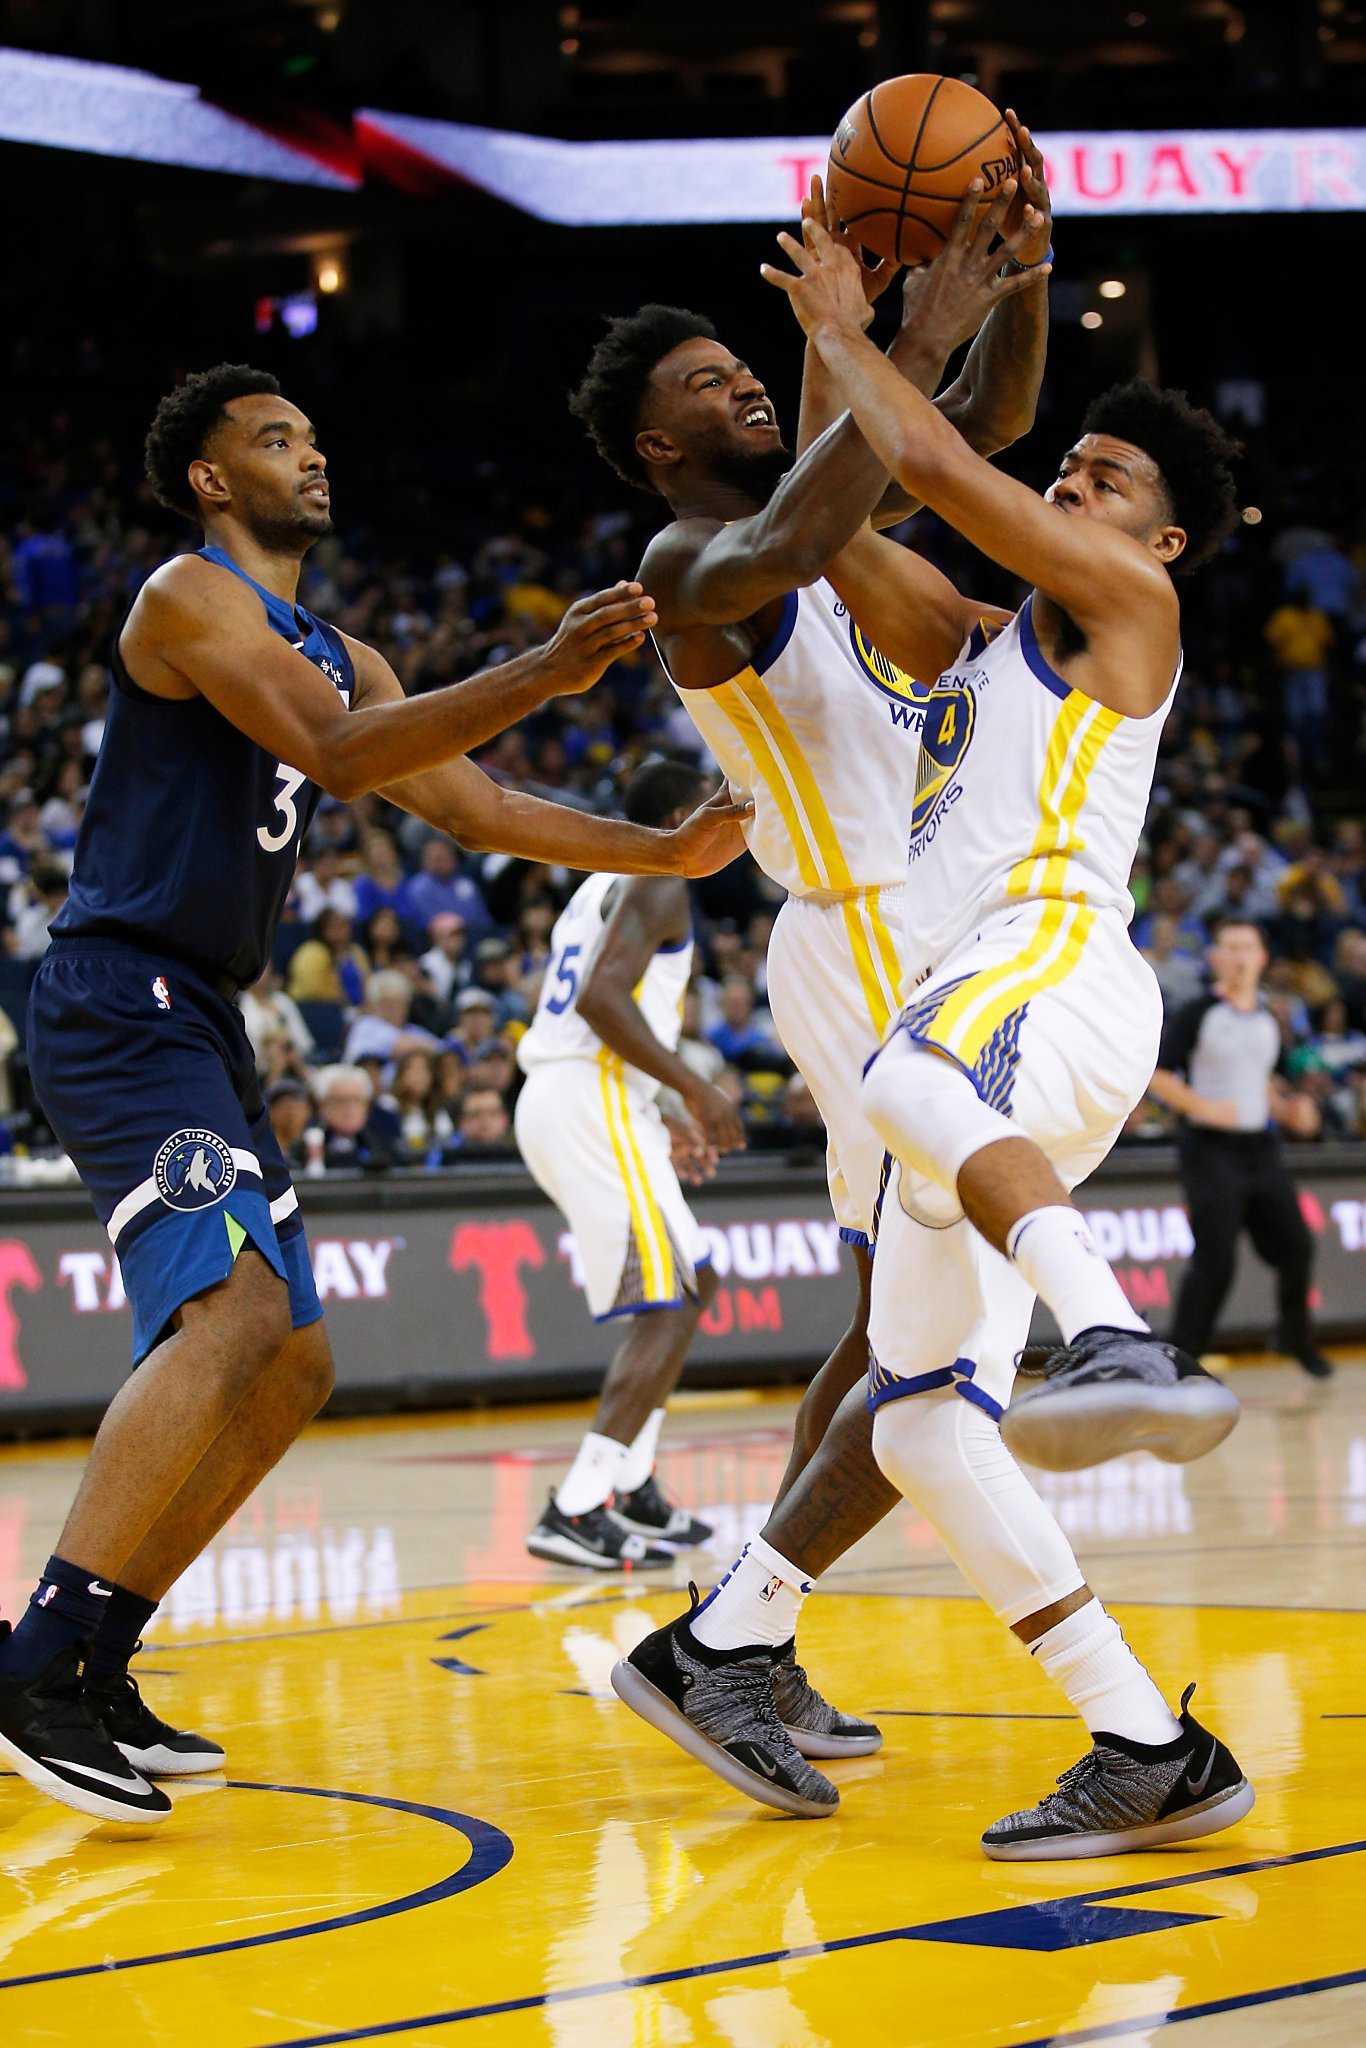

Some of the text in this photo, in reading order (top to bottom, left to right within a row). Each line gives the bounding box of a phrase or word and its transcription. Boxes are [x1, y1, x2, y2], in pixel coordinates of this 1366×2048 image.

[937, 702, 957, 746] 4
[546, 945, 581, 1015] 5
[156, 1132, 234, 1195] MINNESOTA TIMBERWOLVES
